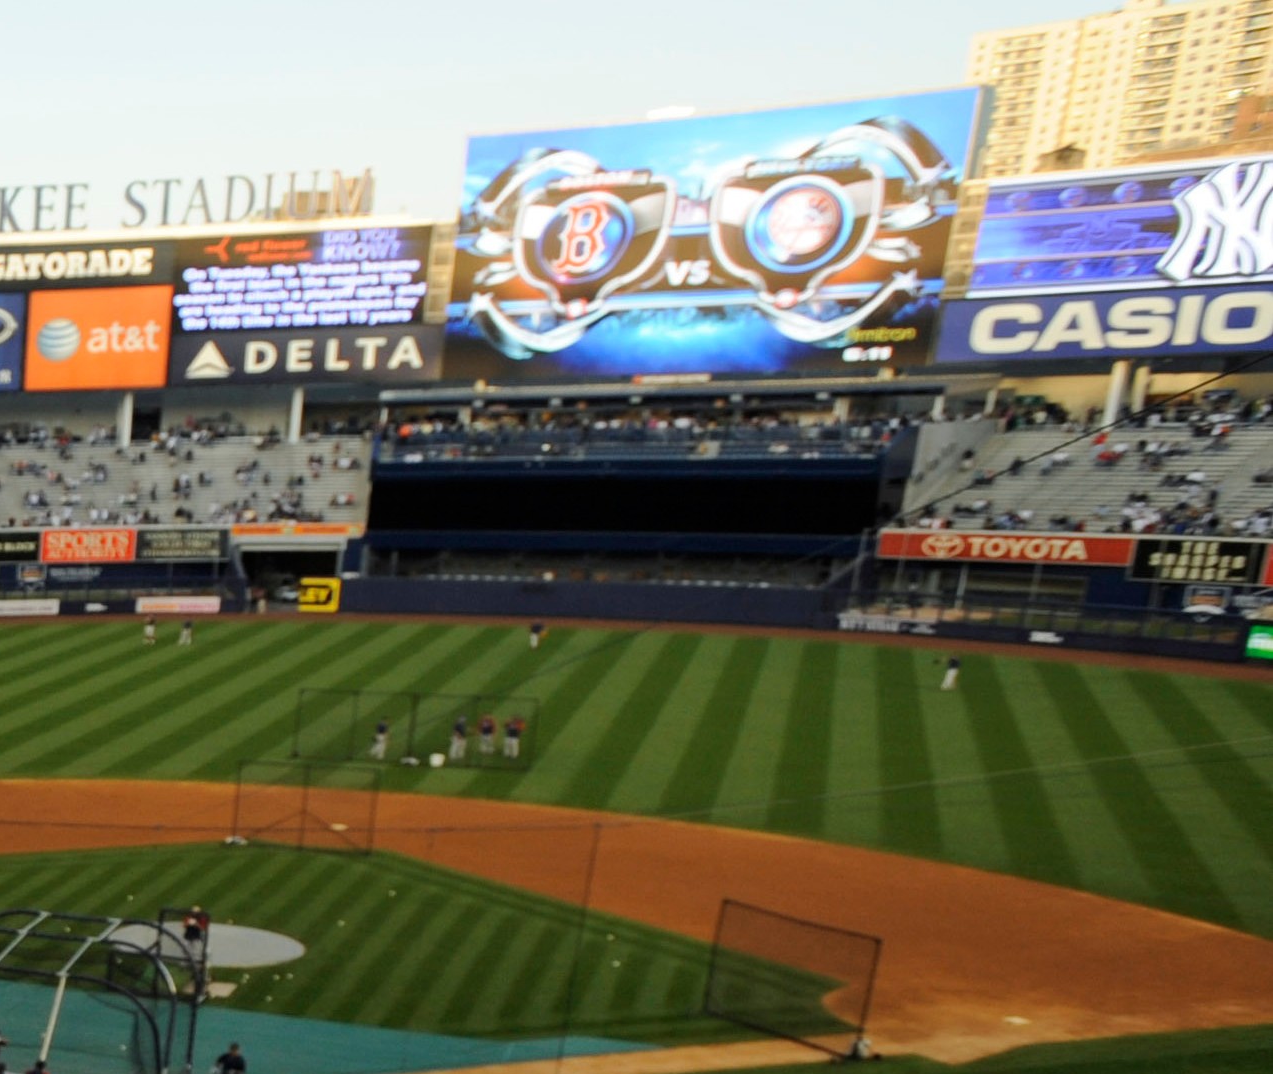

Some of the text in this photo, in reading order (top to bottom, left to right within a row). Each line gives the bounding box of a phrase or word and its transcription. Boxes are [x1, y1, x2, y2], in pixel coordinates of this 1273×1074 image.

[121, 167, 375, 230] STADIUM
[86, 320, 161, 354] at&t
[968, 291, 1273, 355] CASIO
[244, 336, 424, 374] DELTA
[47, 532, 130, 549] SPORTS
[966, 535, 1088, 561] TOYOTA
